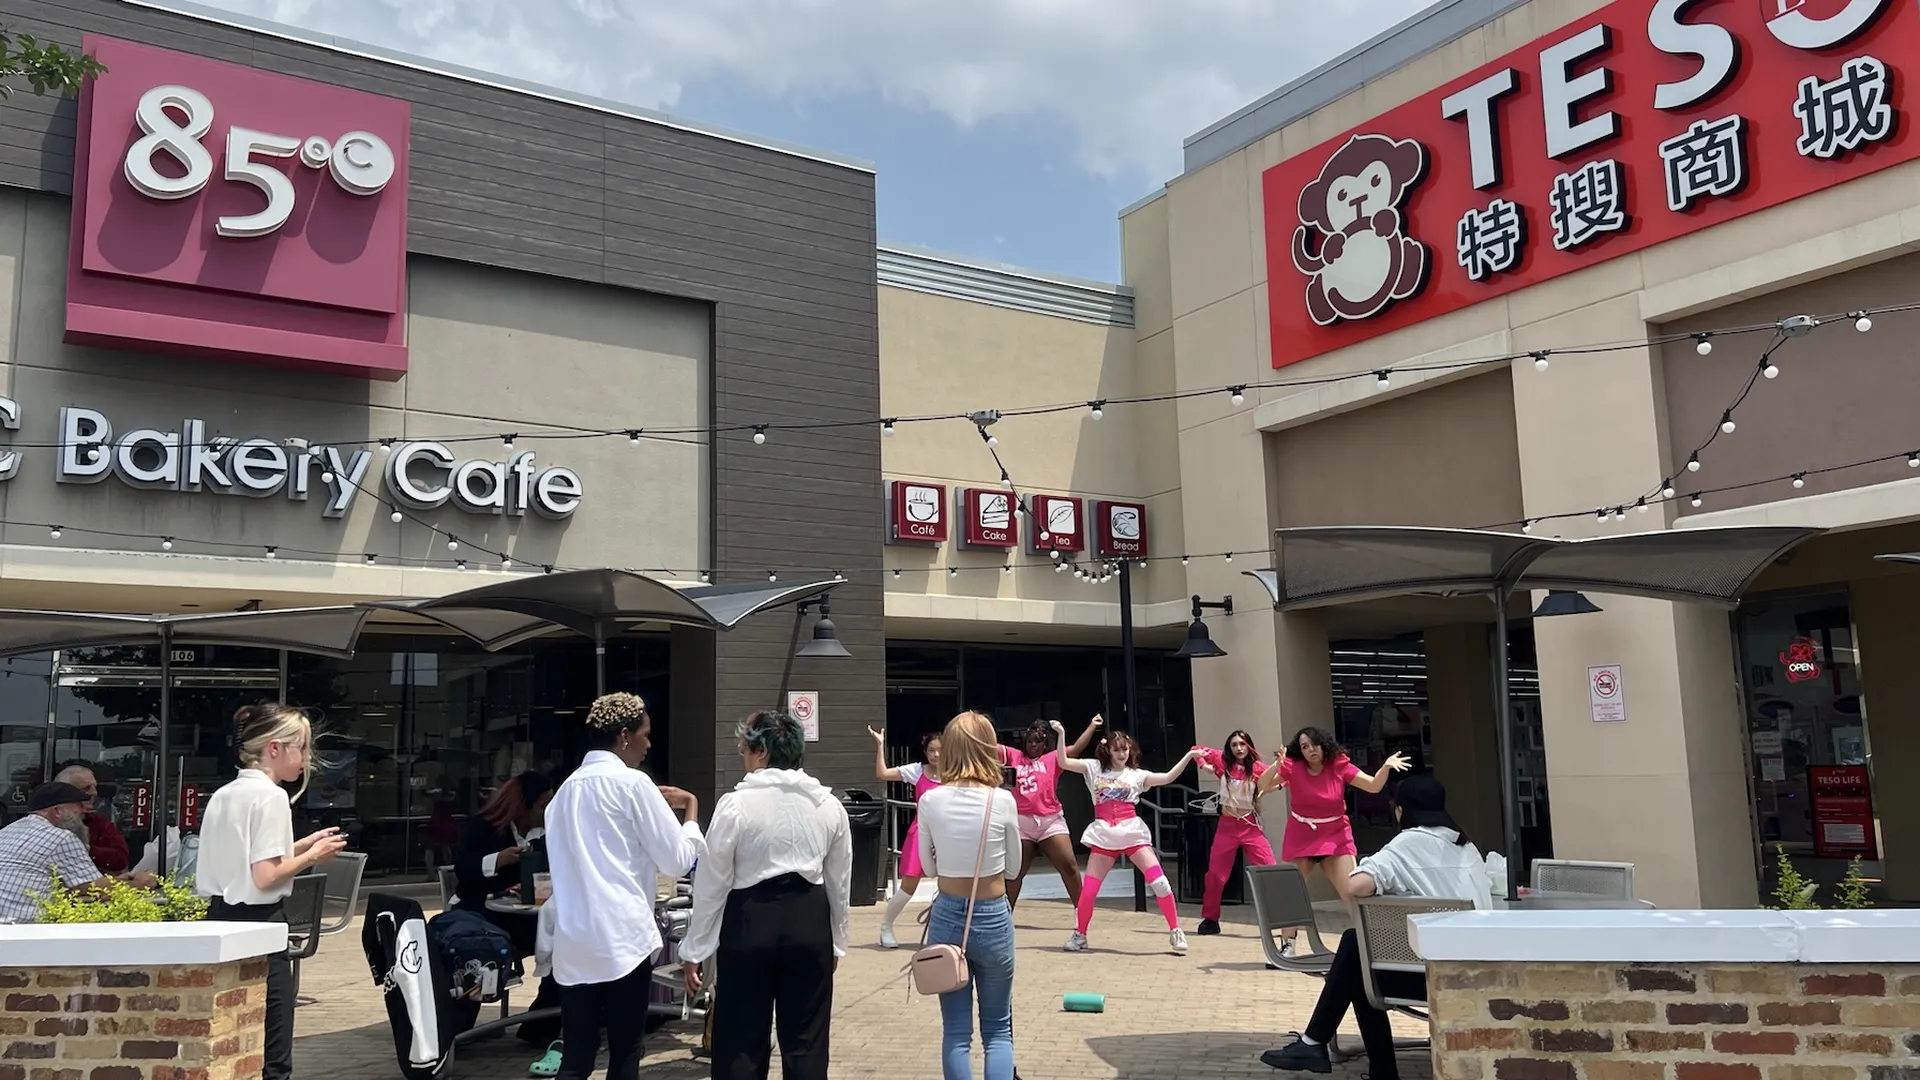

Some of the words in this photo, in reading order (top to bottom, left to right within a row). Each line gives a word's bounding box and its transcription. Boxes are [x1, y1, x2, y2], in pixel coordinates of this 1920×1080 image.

[1457, 56, 1891, 281] 特搜商城
[58, 405, 374, 517] Bakery
[387, 441, 584, 518] Cafe
[910, 524, 935, 536] Café
[982, 530, 1007, 541] Cake
[1055, 535, 1070, 546] Tea
[1113, 540, 1139, 551] Bread
[172, 651, 194, 661] 106
[1788, 662, 1814, 672] OPEN
[1018, 775, 1038, 794] 25
[1842, 776, 1861, 784] LIFE
[137, 788, 147, 826] PULL
[185, 788, 195, 826] PULL
